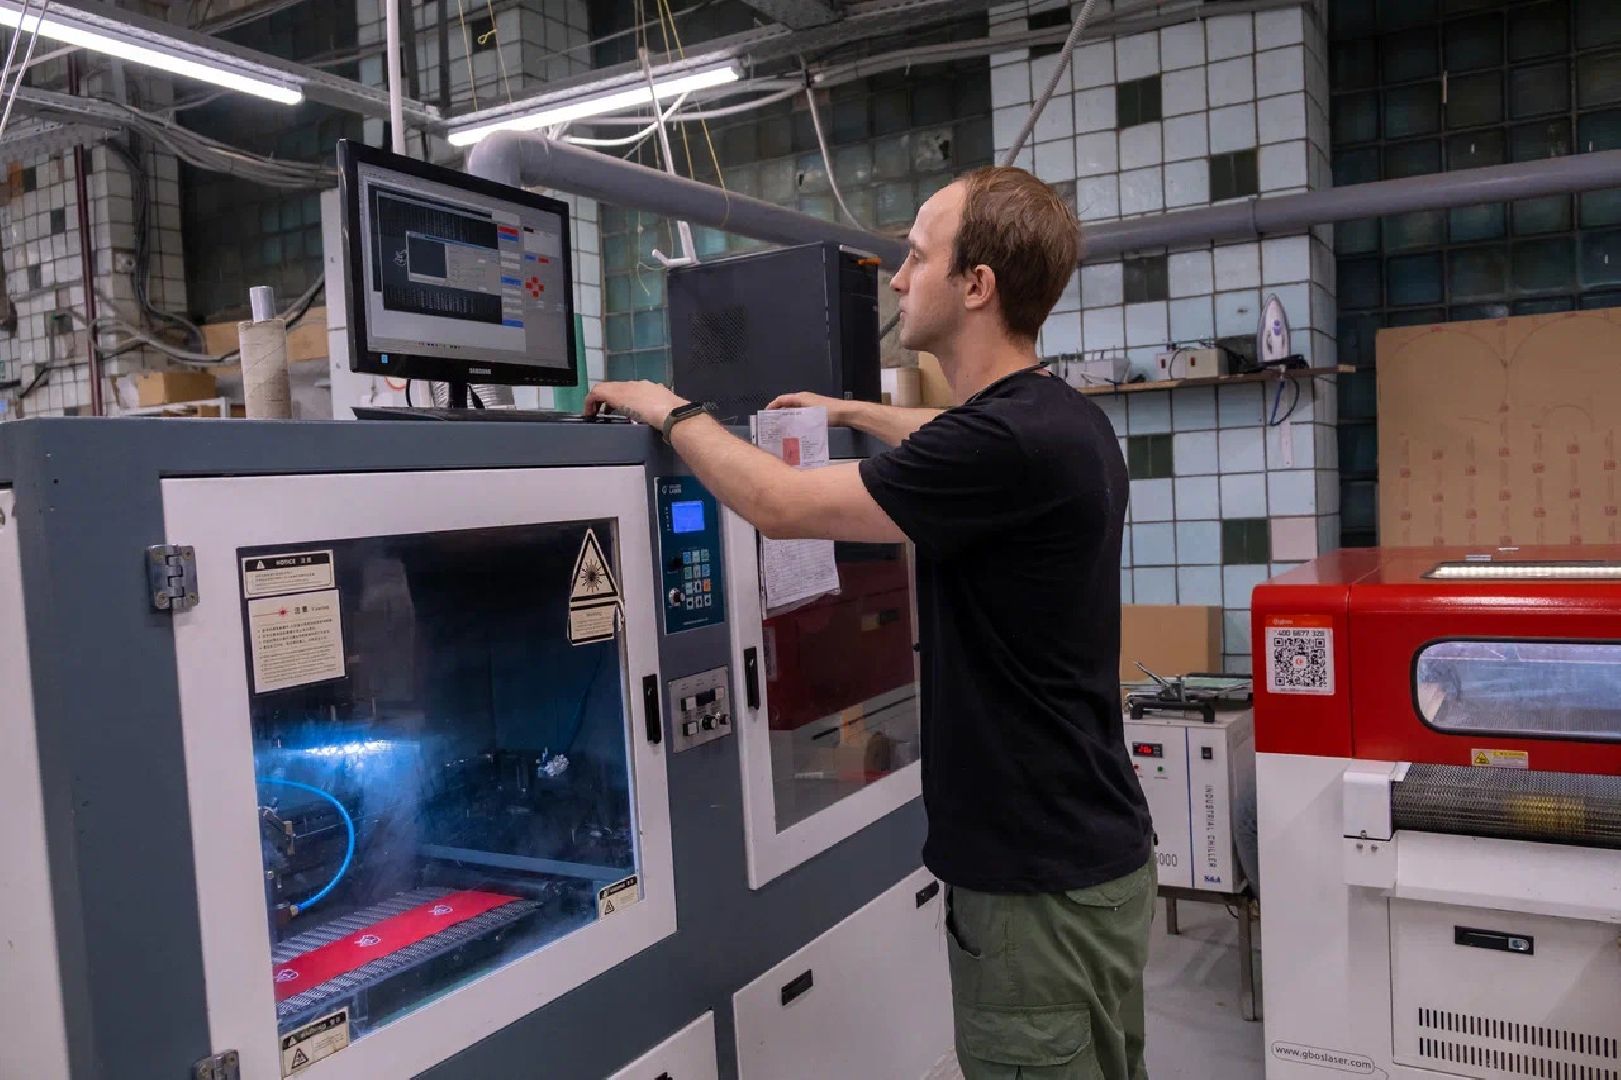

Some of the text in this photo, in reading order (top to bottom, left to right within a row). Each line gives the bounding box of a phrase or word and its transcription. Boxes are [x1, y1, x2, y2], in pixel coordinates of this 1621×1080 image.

[468, 367, 492, 375] SAMSUNG
[1204, 784, 1218, 868] INDUSTRIAL CHILLER
[1274, 1046, 1372, 1069] www.gboslaser.com
